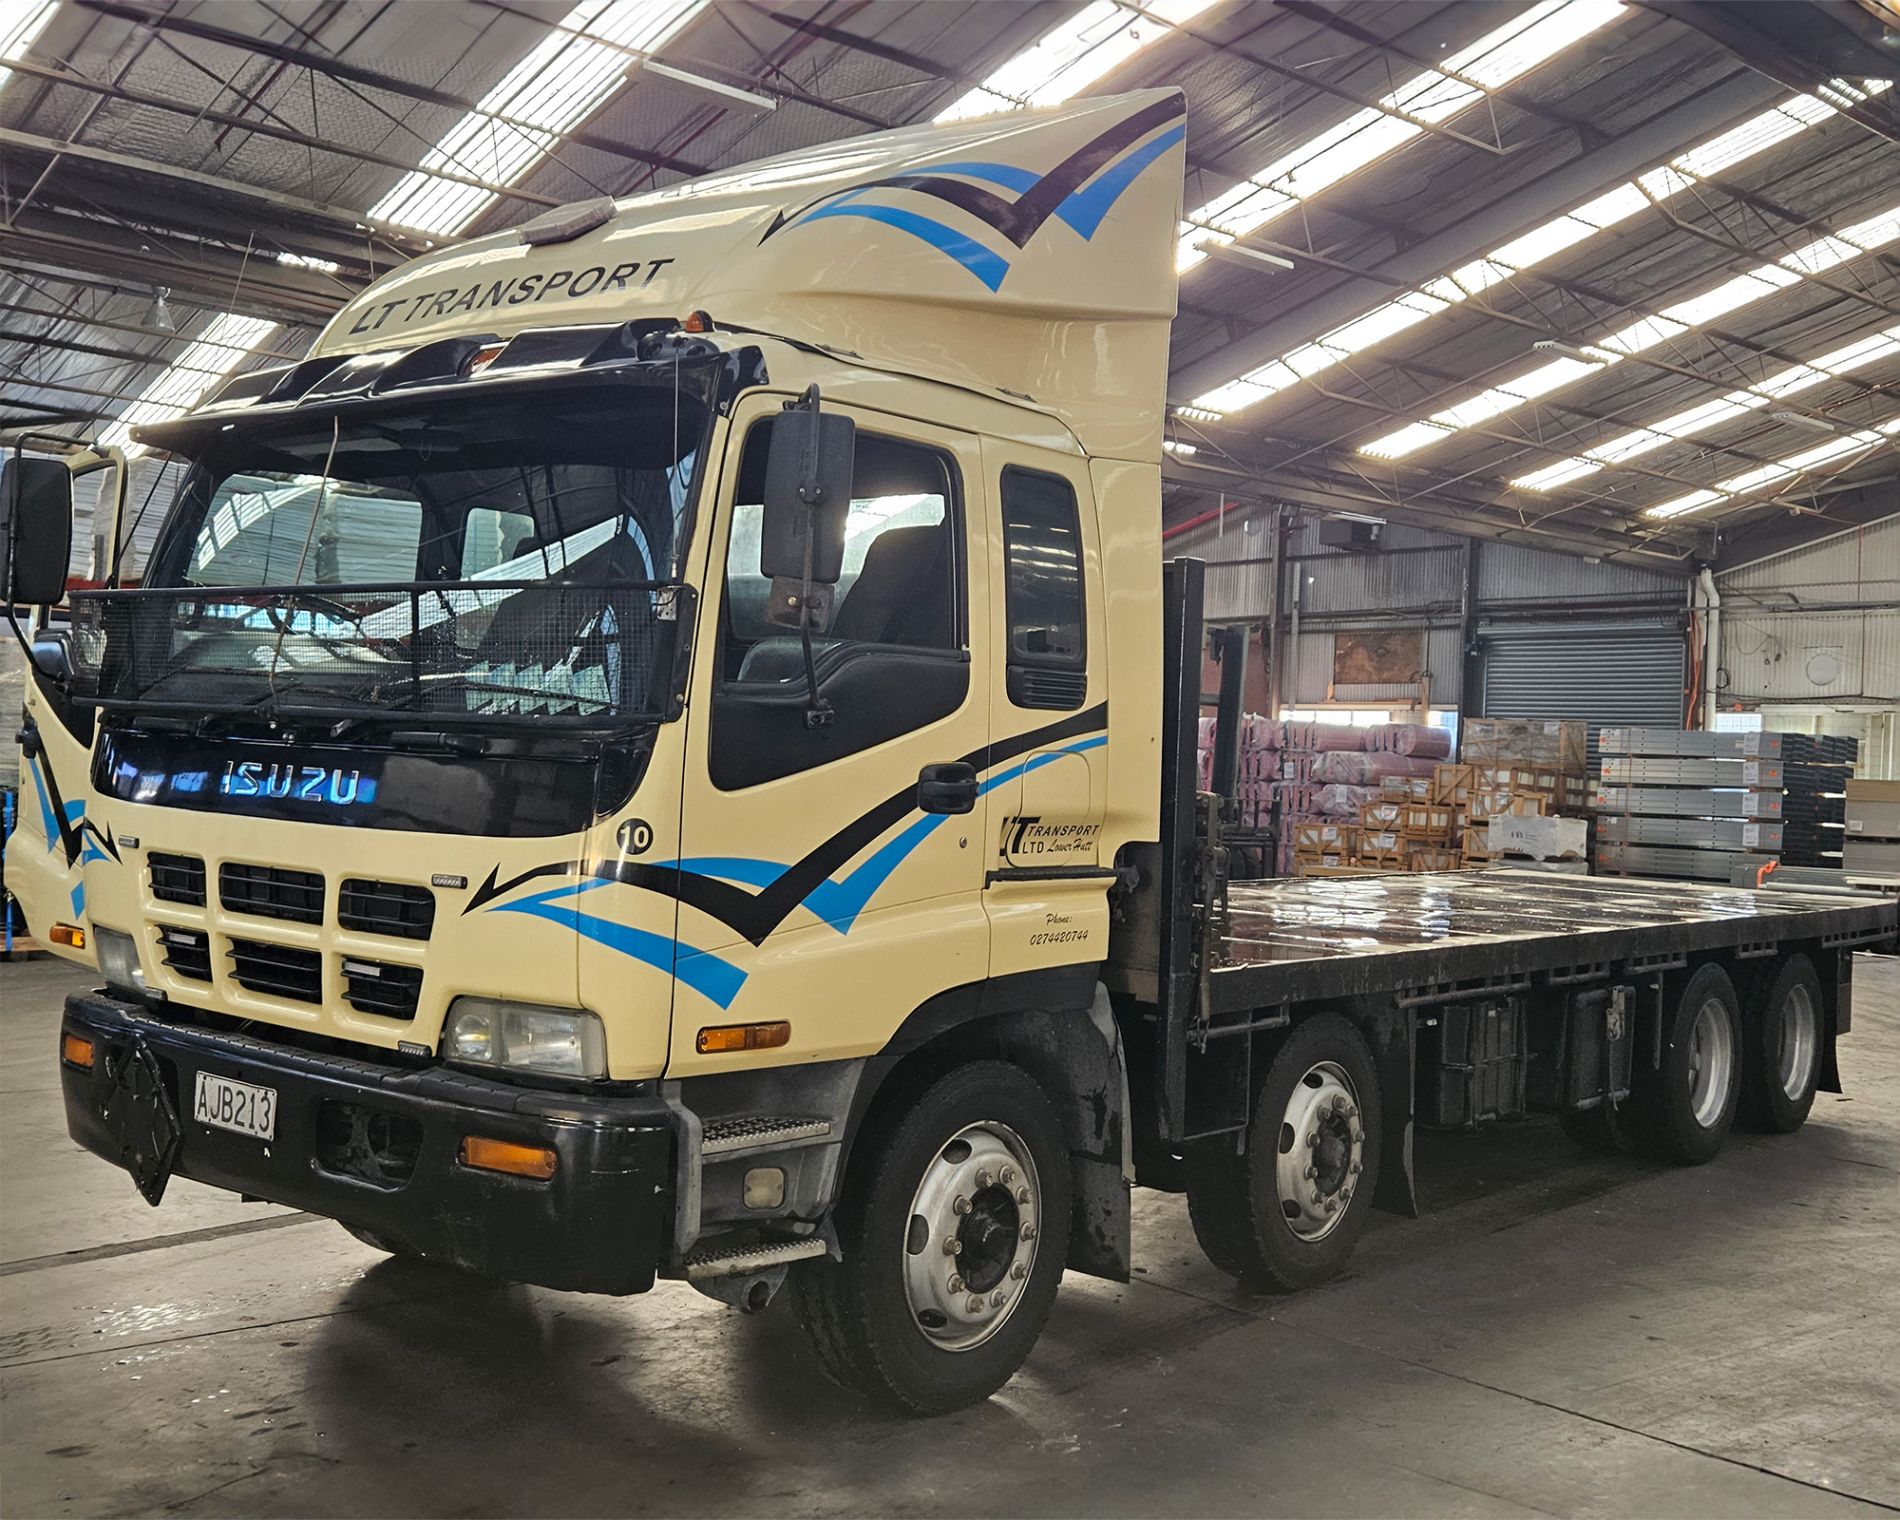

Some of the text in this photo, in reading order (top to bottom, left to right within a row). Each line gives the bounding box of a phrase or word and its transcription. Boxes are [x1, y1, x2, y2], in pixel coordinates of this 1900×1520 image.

[349, 257, 676, 336] LT TRANSPORT
[221, 760, 360, 805] ISUZU
[620, 825, 650, 848] 10
[1027, 824, 1100, 837] TRANSPORT
[1022, 838, 1093, 854] LTD Lower Hutt
[1046, 913, 1073, 926] Phone:
[1029, 930, 1089, 946] 0274420744
[197, 1080, 272, 1133] AJB213
